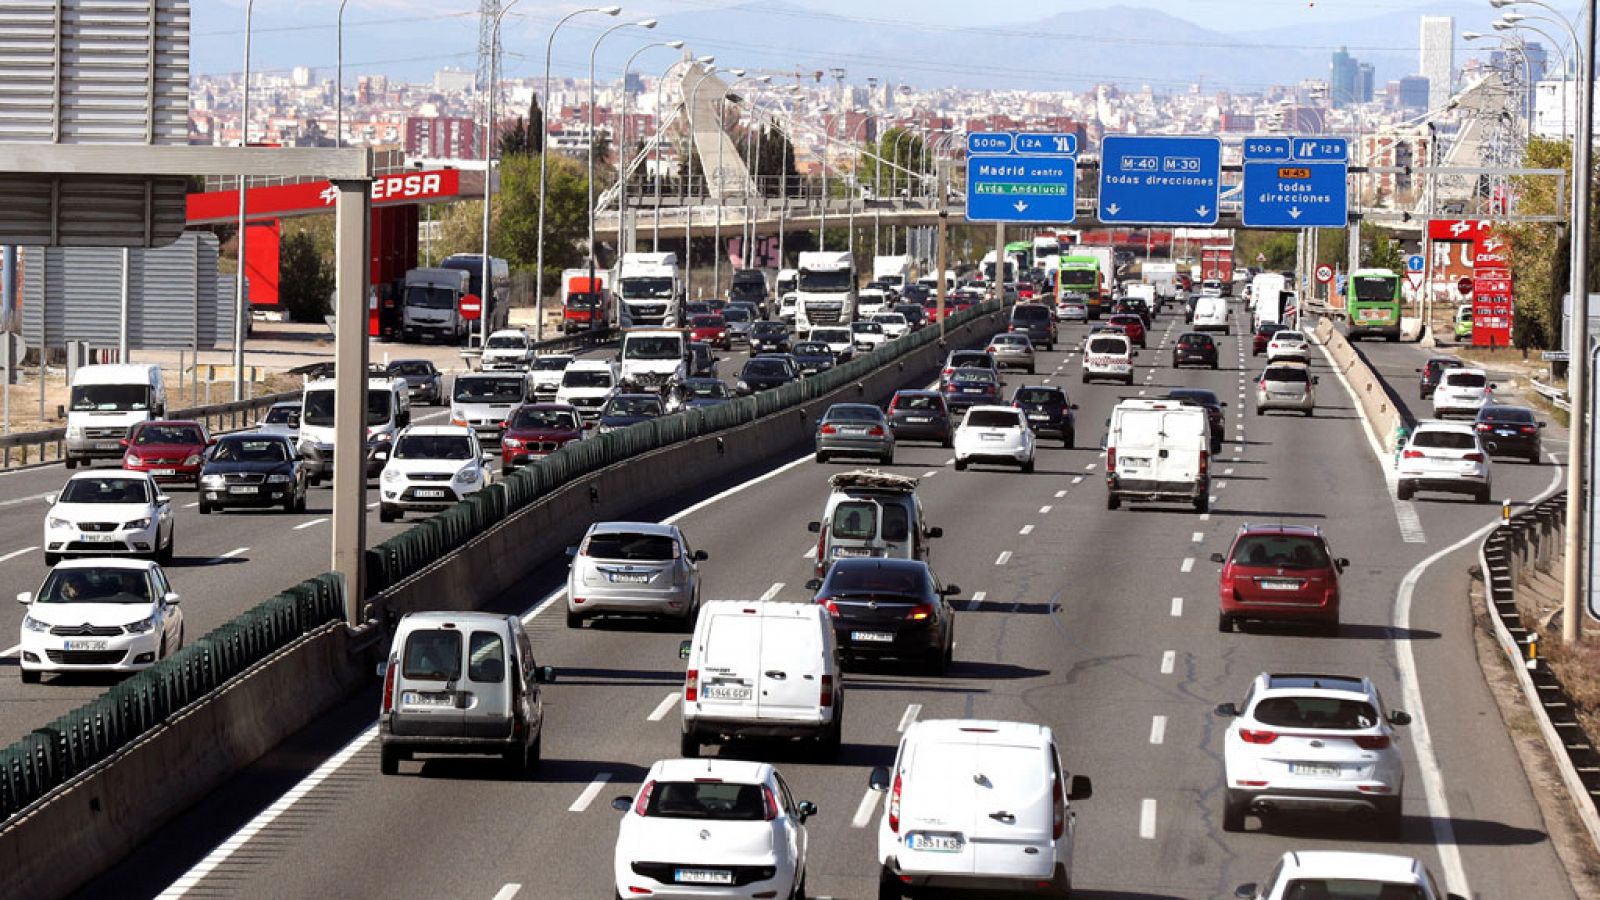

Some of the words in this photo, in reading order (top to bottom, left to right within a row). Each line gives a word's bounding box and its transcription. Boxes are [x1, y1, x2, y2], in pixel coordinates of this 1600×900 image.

[1021, 139, 1042, 148] 12A
[1250, 145, 1271, 153] 500
[1321, 145, 1340, 154] 12B
[1123, 158, 1156, 168] M-40
[1166, 160, 1198, 170] M-30
[979, 165, 1025, 176] Madrid
[1031, 168, 1063, 176] centro
[371, 173, 440, 199] EPSA
[1105, 175, 1140, 185] todas
[1146, 176, 1214, 187] direcciones
[1278, 183, 1312, 192] todas
[1259, 192, 1331, 203] direcciones
